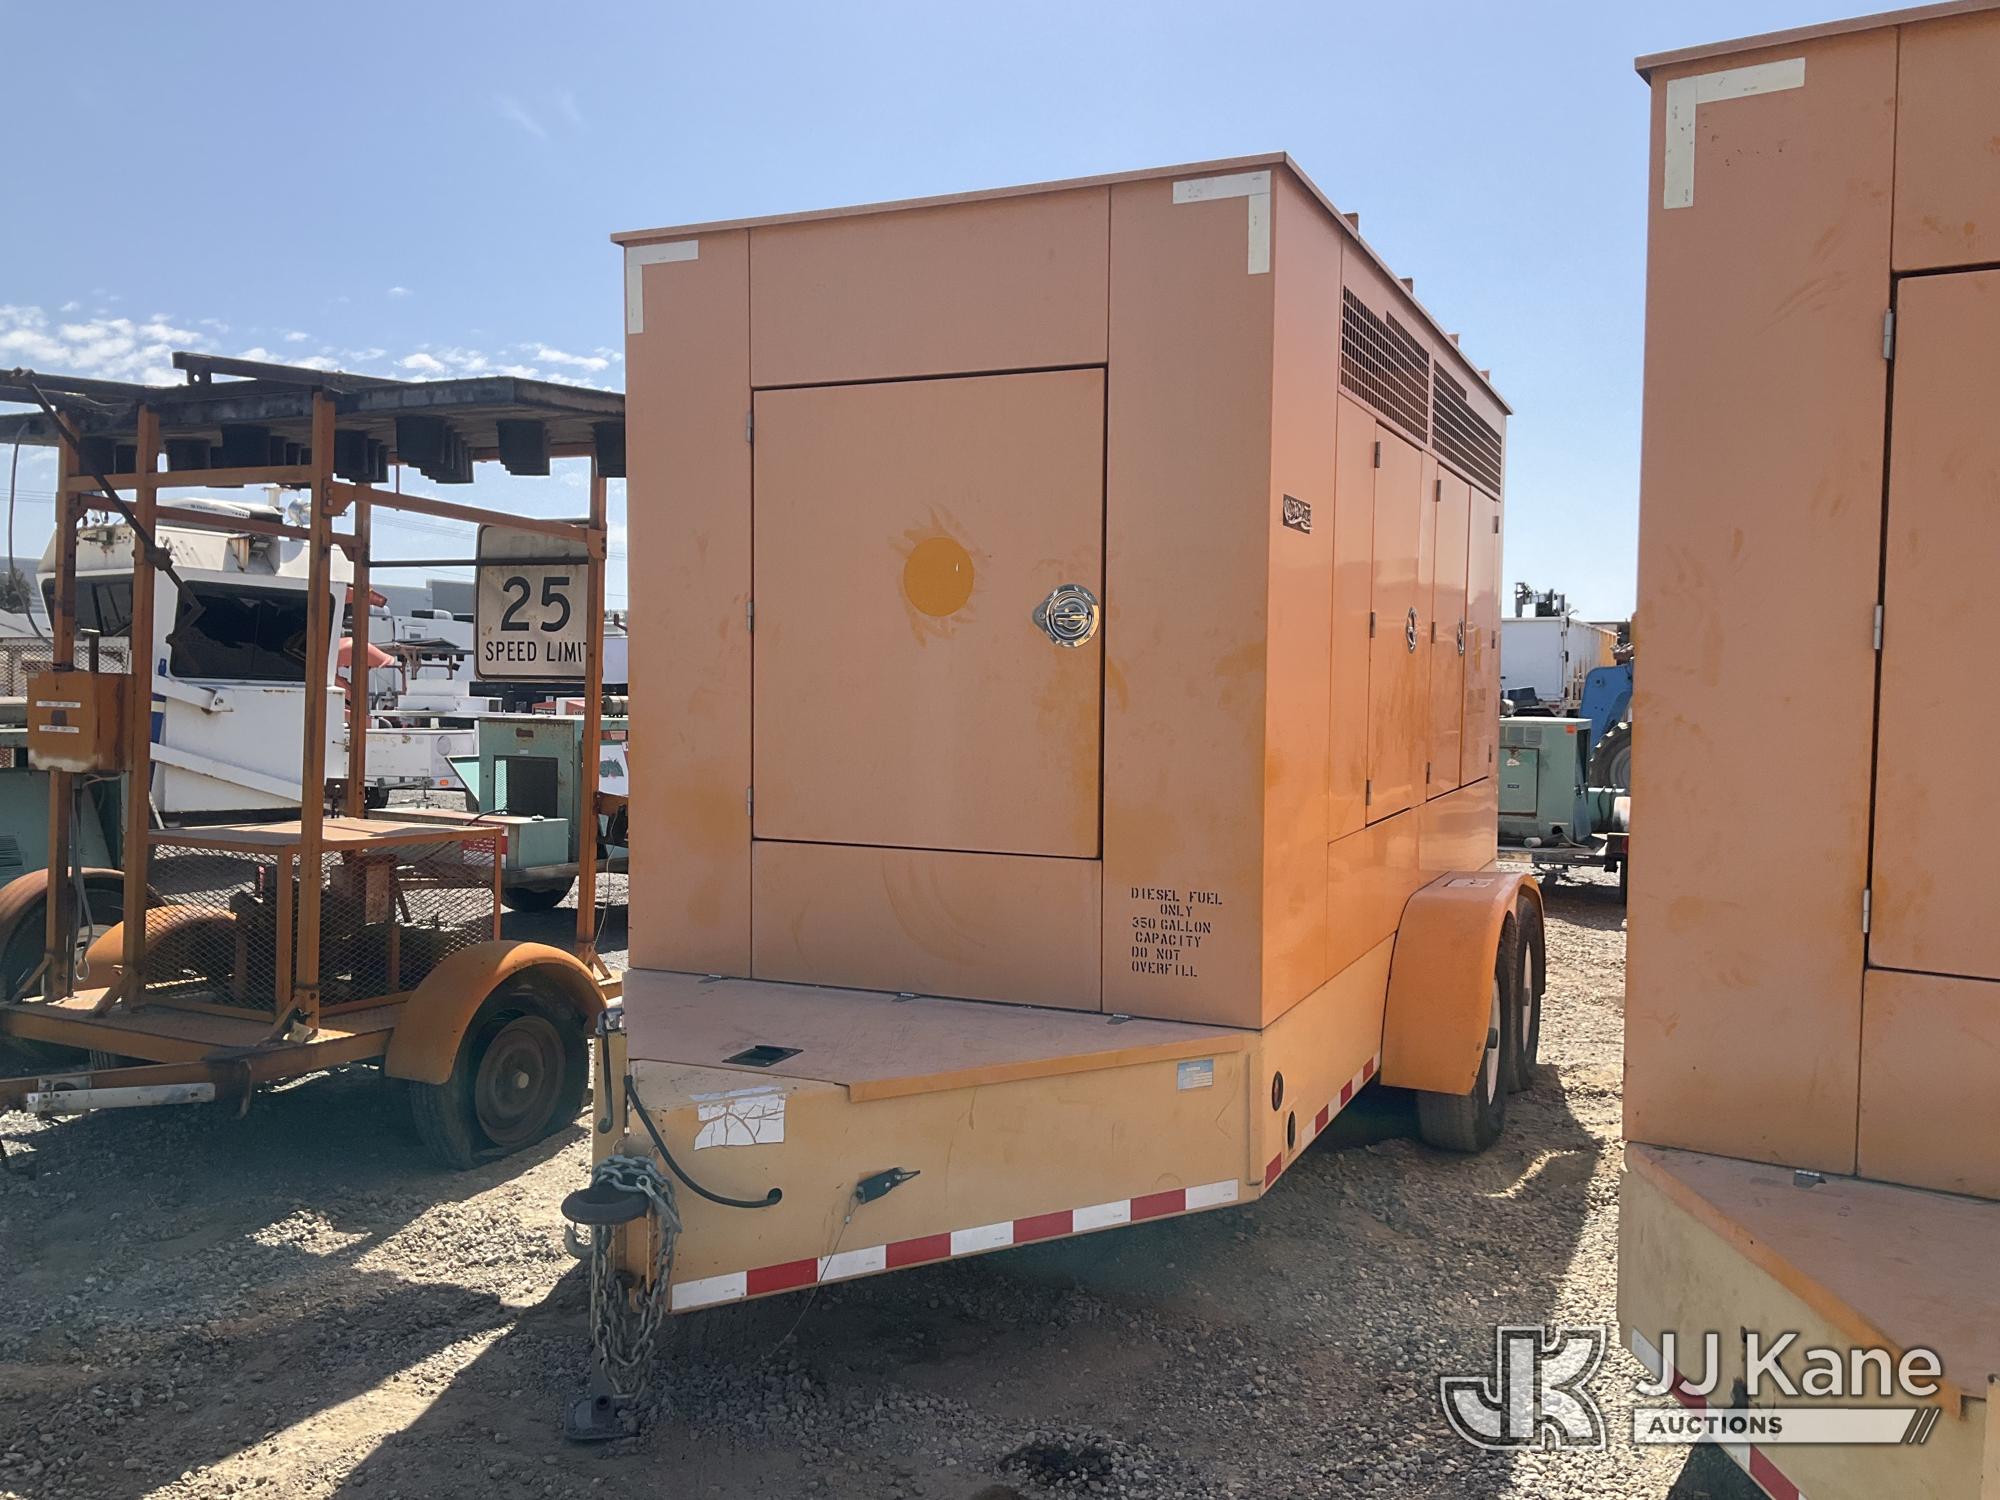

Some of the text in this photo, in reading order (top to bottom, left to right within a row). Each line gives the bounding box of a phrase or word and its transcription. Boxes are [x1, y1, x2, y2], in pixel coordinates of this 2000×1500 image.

[500, 576, 571, 633] 25
[485, 641, 537, 662] SPEED
[1131, 887, 1223, 905] DIESEL FUEL
[1160, 903, 1193, 918] ONLY
[1132, 916, 1211, 934] 350 GALLON
[1135, 931, 1201, 948] CAPACITY
[1131, 945, 1181, 961] DO NOT
[1131, 960, 1198, 977] OVERFILL
